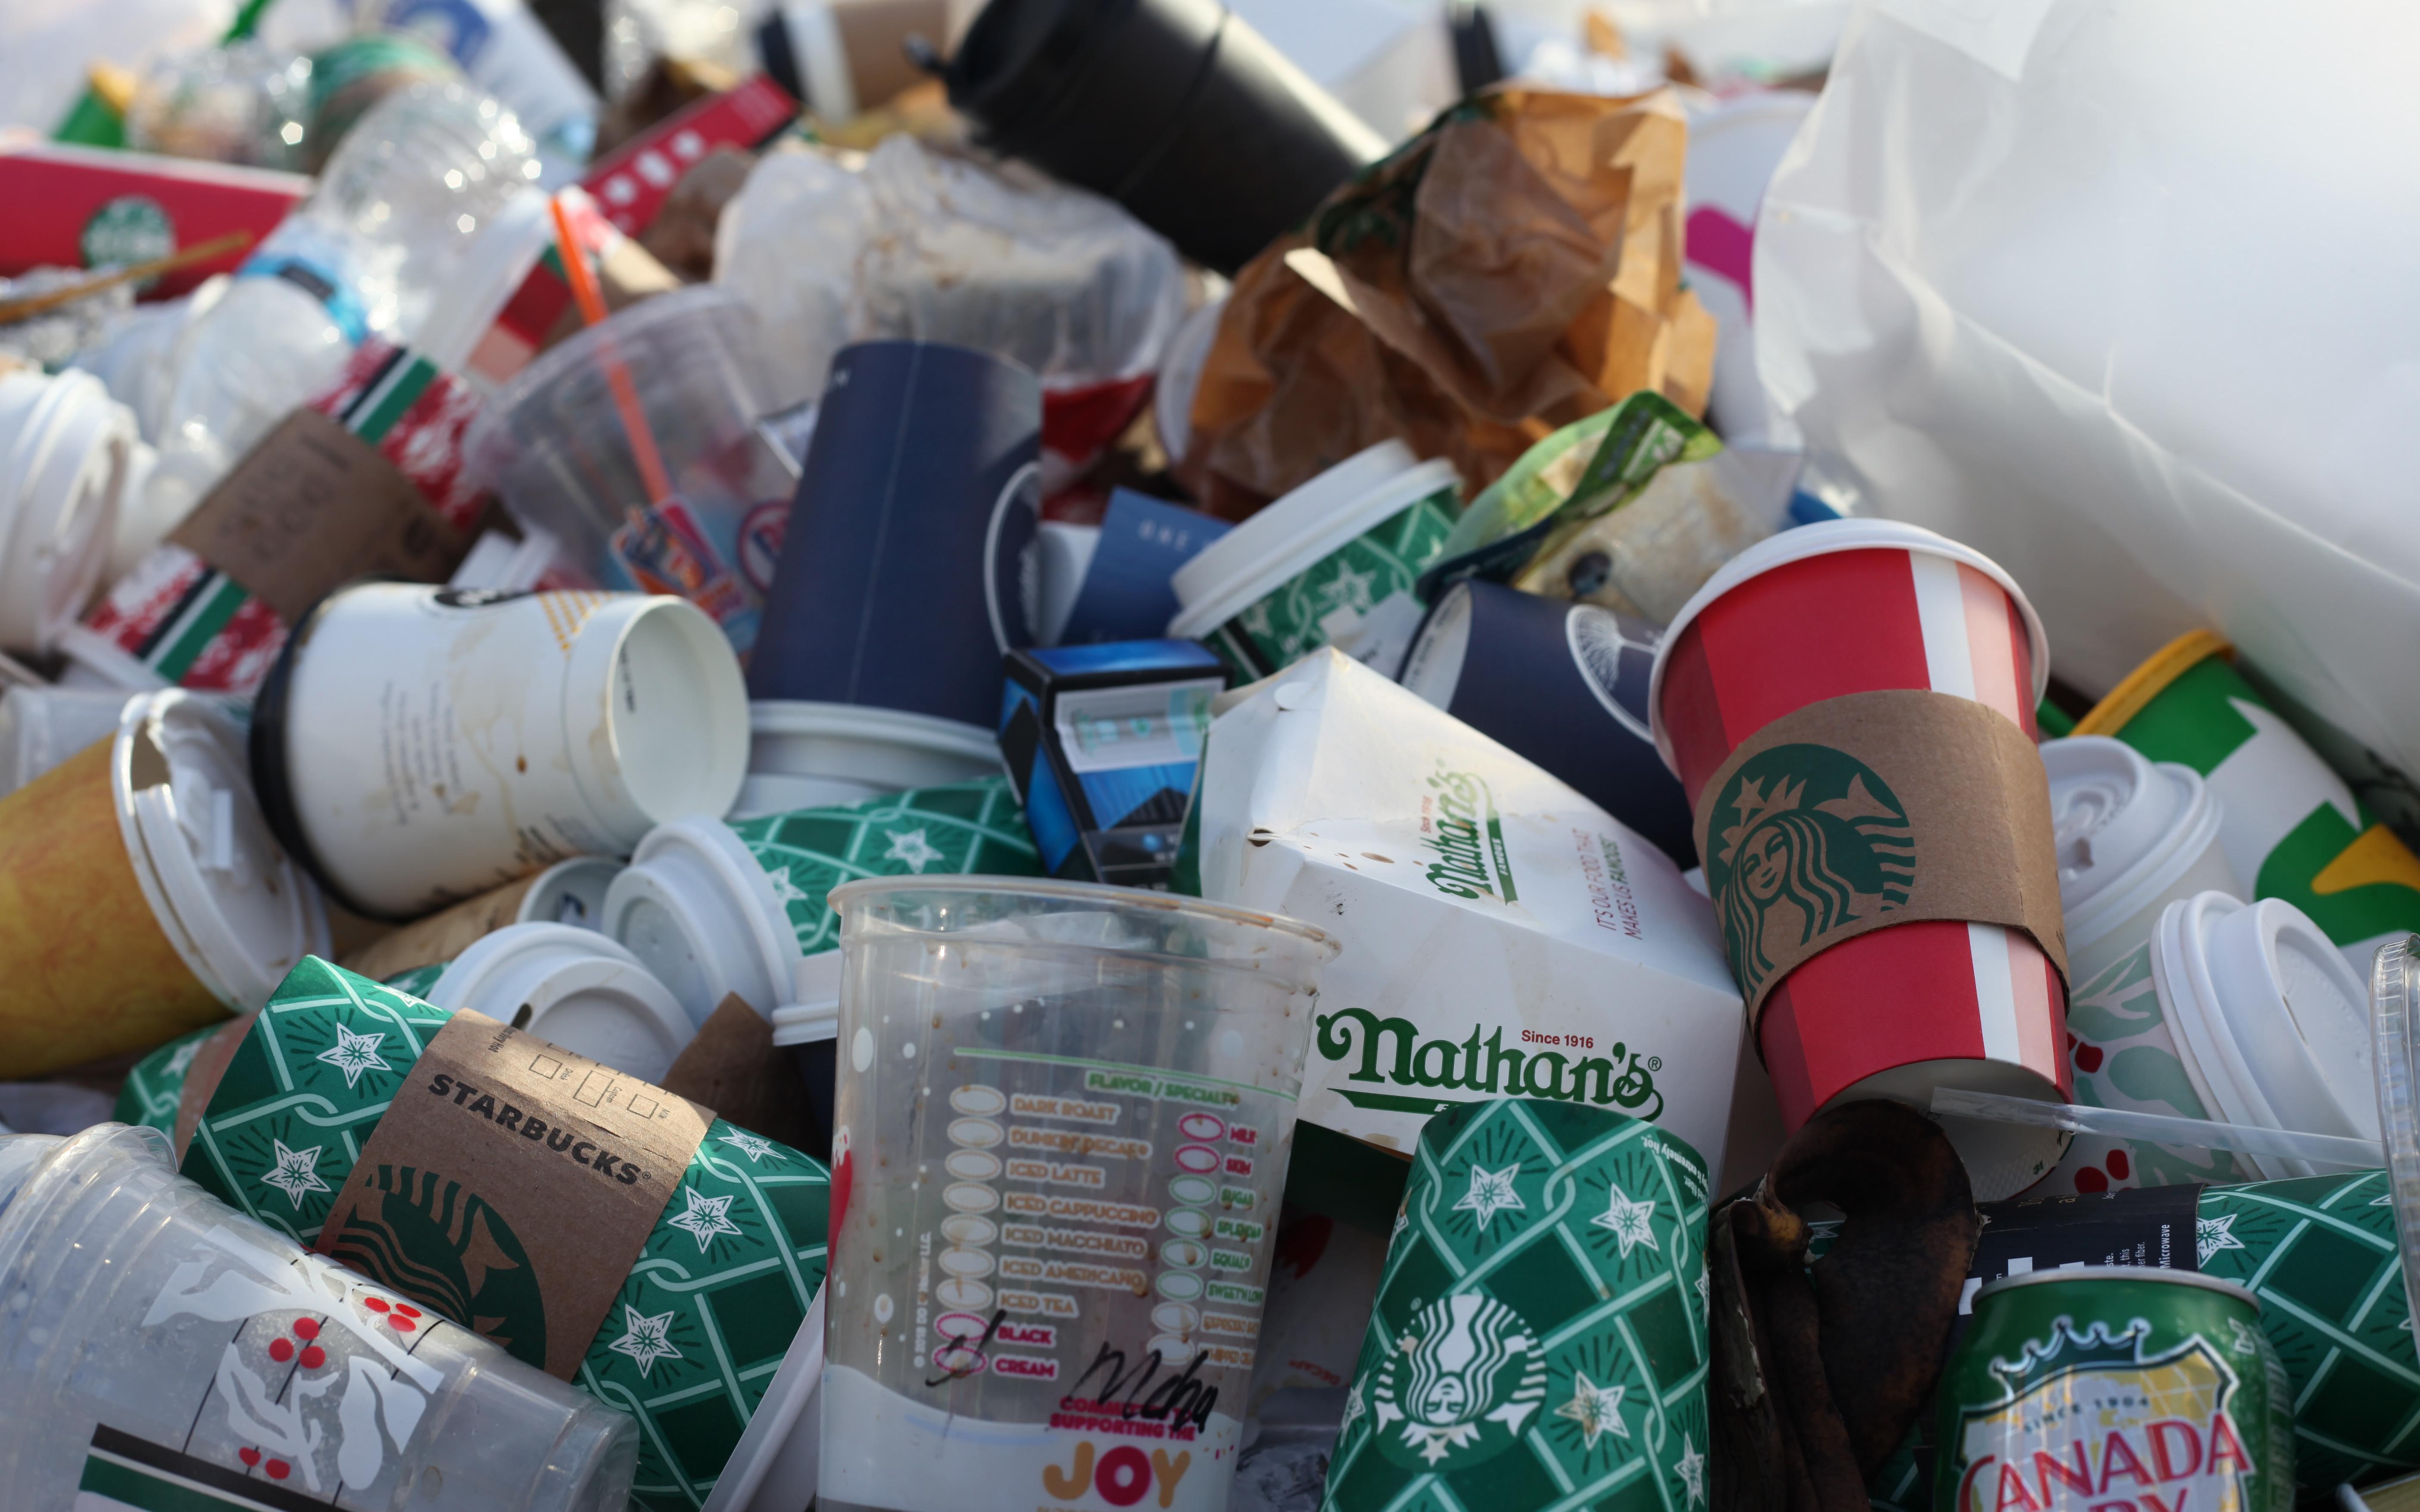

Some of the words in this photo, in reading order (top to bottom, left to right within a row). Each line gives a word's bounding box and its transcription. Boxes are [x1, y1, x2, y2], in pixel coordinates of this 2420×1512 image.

[1589, 884, 1611, 908] OUR
[1612, 884, 1632, 899] US
[1594, 909, 1616, 930] IT'S
[1617, 899, 1643, 940] MAKES
[488, 1041, 505, 1053] Hot
[1522, 1029, 1560, 1046] Since
[1564, 1033, 1594, 1049] 1916
[560, 1068, 574, 1081] Drink
[606, 1086, 622, 1103] Custom
[1088, 1074, 1154, 1094] FLAVOR
[1166, 1083, 1237, 1106] SPECIALTY
[658, 1108, 670, 1120] Milk
[1014, 1098, 1056, 1114] DARK
[1061, 1101, 1117, 1121] ROAST
[1640, 1136, 1660, 1154] hot.
[1661, 1143, 1697, 1176] extremely
[1007, 1162, 1048, 1179] ICED
[1052, 1164, 1102, 1185] LATTE
[1007, 1195, 1045, 1212] ICED
[1050, 1198, 1157, 1224] CAPPUCCINO
[1004, 1226, 1043, 1244] ICED
[1048, 1230, 1144, 1254] MACCHIATO
[2135, 1241, 2146, 1258] fiber.
[2158, 1223, 2171, 1269] Microwave
[2120, 1248, 2130, 1261] this
[1002, 1259, 1042, 1276] ICED
[1046, 1262, 1141, 1287] AMERICANO
[1001, 1291, 1039, 1308] ICED
[1045, 1294, 1074, 1313] TEA
[997, 1325, 1052, 1344] BLACK
[995, 1358, 1056, 1376] CREAM
[1050, 1413, 1164, 1438] SUPPORTING
[1168, 1423, 1195, 1441] THE
[2024, 1404, 2081, 1434] SINCE
[1043, 1440, 1191, 1509] JOY
[1960, 1414, 2250, 1512] CANADA
